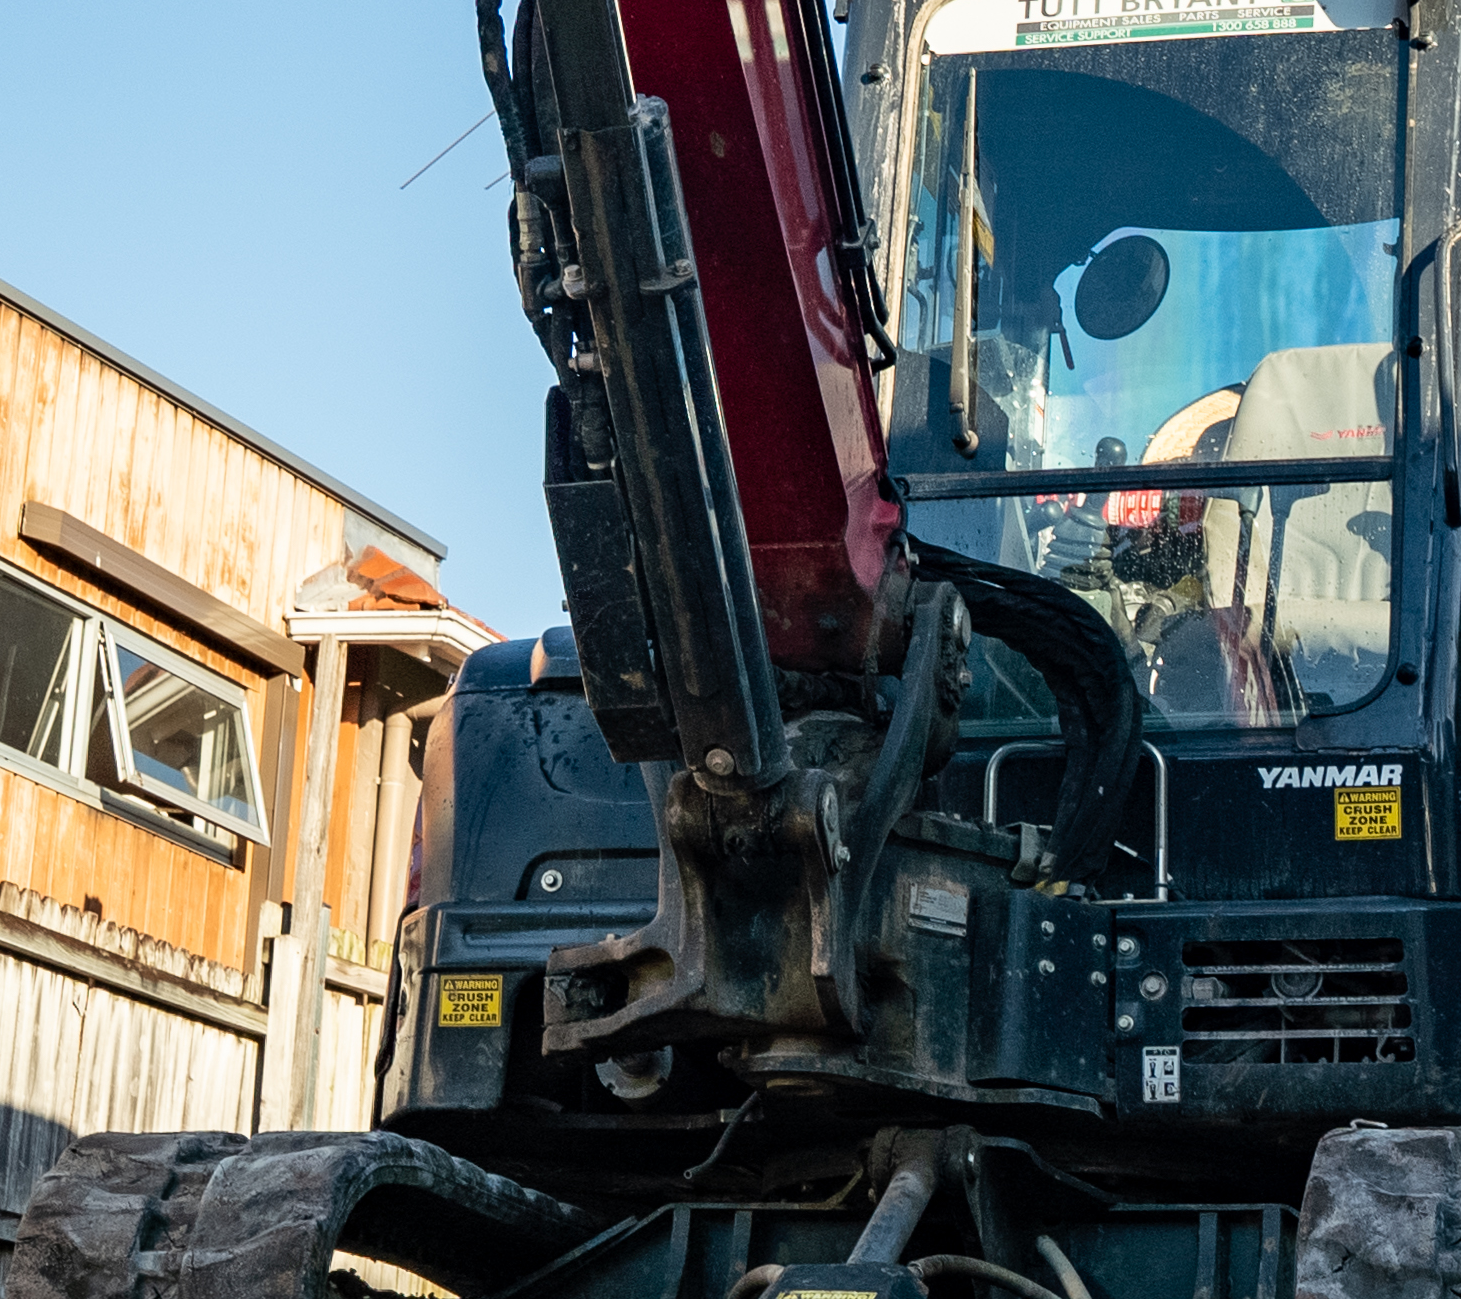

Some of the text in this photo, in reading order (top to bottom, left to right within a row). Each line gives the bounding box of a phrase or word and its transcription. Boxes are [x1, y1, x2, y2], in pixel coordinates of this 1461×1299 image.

[1040, 6, 1292, 31] EQUIPMENT SALES PARTS SERVICE
[1212, 18, 1297, 32] 1300 658 888
[1025, 27, 1132, 45] SERVICE SUPPORT
[1257, 764, 1403, 789] YANMAR
[1350, 792, 1396, 802] WARNING
[1344, 805, 1393, 814] CRUSH
[1349, 816, 1387, 825] ZONE
[1339, 825, 1397, 835] KEEP CLEAR
[455, 979, 498, 990] WARNING
[448, 992, 494, 1002] CRUSH
[452, 1003, 489, 1012] ZONE
[442, 1013, 497, 1022] KEEP CLEAR
